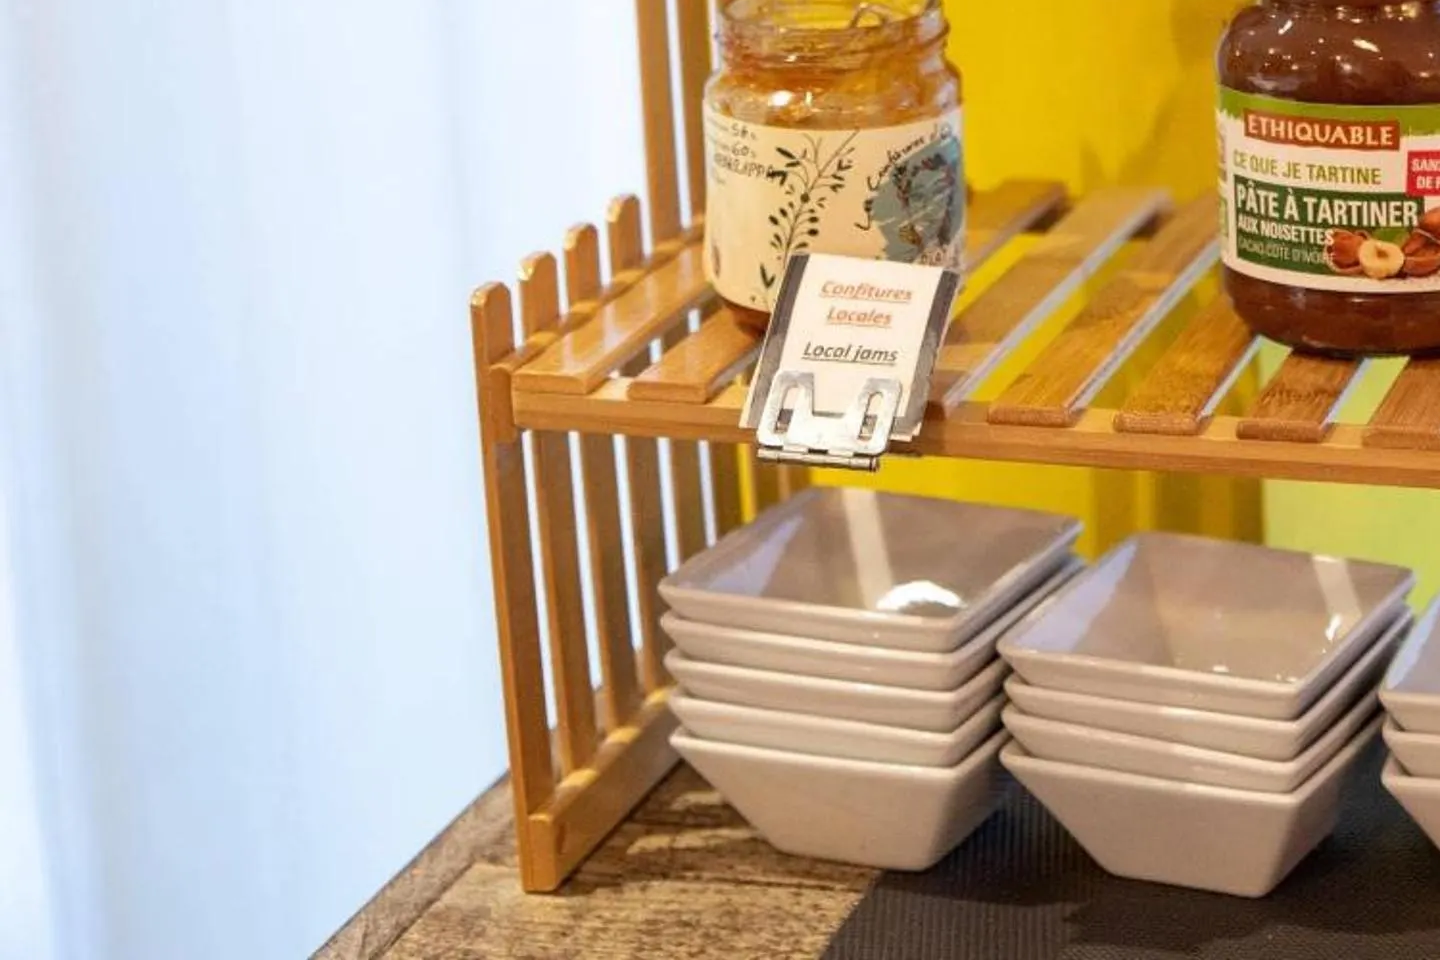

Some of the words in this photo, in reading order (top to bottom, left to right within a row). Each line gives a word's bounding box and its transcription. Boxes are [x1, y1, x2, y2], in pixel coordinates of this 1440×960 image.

[1247, 114, 1394, 146] ETHIQUABLE
[1250, 154, 1278, 175] QUE
[1282, 160, 1302, 180] JE
[1305, 163, 1382, 185] TARTINE
[1416, 175, 1434, 189] DE
[1236, 181, 1280, 218] PÂTE
[1283, 188, 1300, 221] À
[1303, 196, 1419, 228] TARTINER
[1238, 214, 1259, 234] AUX
[1261, 220, 1335, 245] NOISETTES
[821, 280, 913, 301] Confitures
[827, 306, 892, 325] Locales
[803, 342, 850, 358] Local
[852, 344, 899, 363] jams
